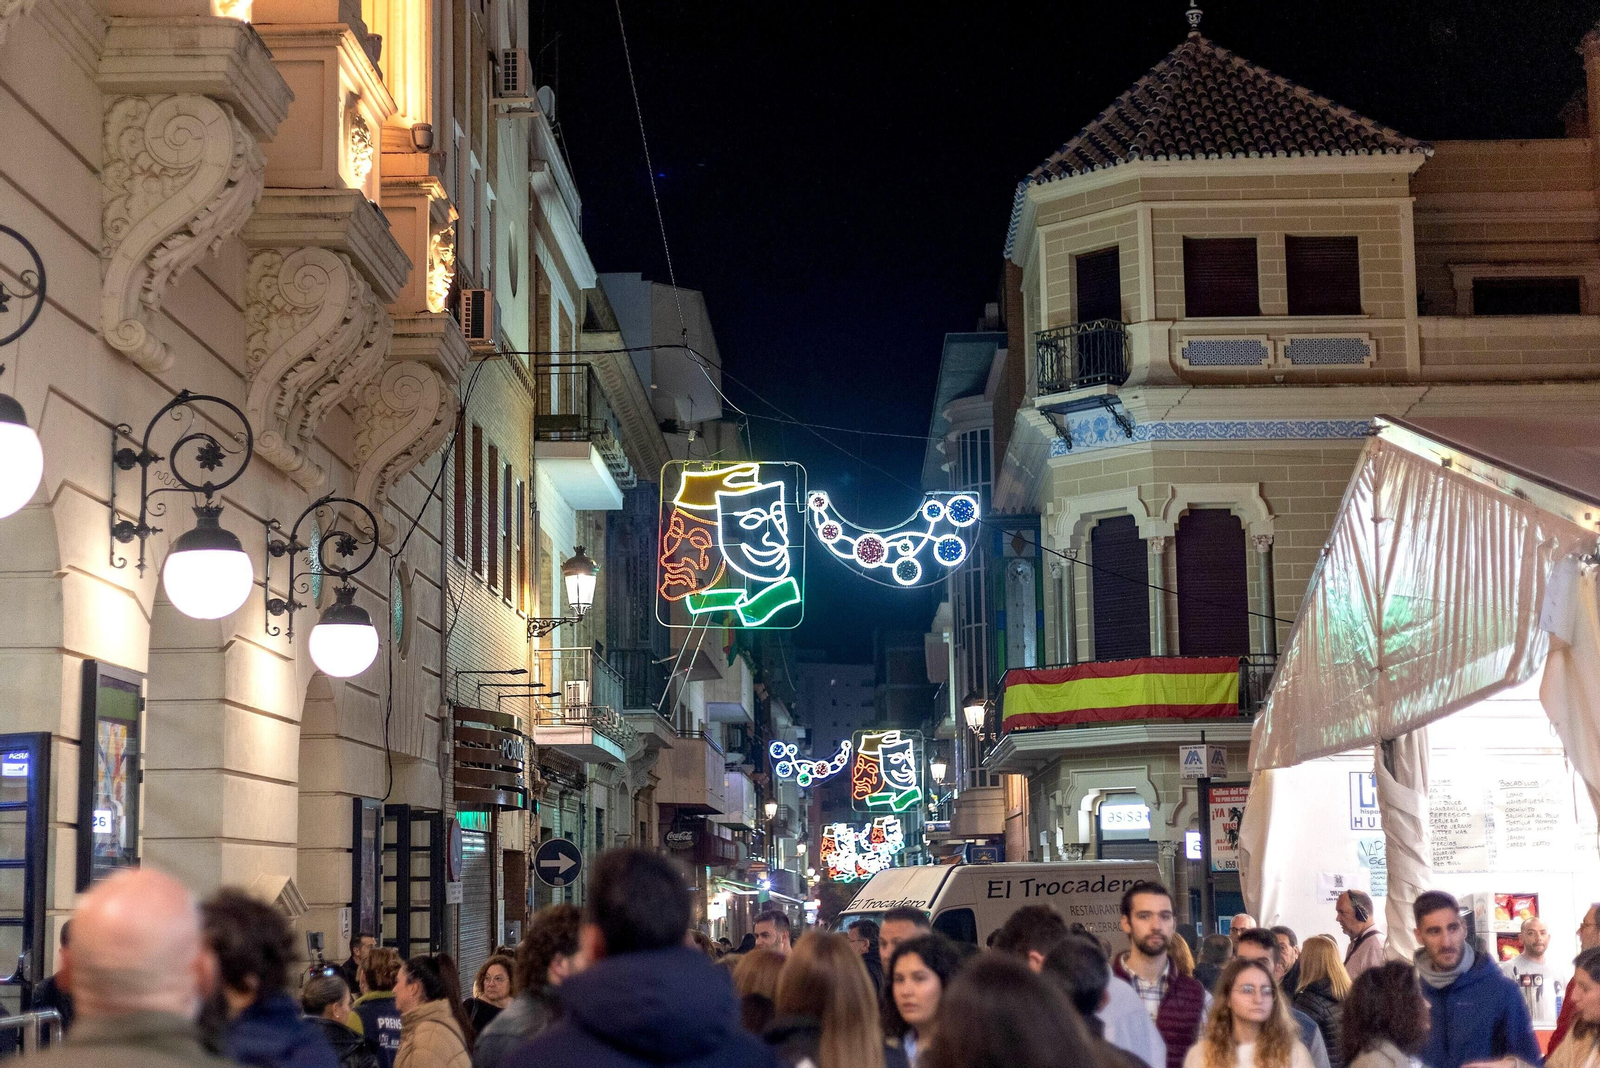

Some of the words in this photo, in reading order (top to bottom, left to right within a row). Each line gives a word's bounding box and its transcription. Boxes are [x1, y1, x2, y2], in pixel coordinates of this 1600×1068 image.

[1498, 779, 1540, 788] BOCADILLOS
[1107, 811, 1142, 822] asisa
[1354, 816, 1383, 828] HU
[1222, 822, 1239, 832] VIS
[1360, 840, 1386, 856] VAP
[987, 880, 1011, 899] El
[848, 899, 861, 911] El
[862, 897, 927, 909] Trocadero
[377, 1017, 402, 1030] PRENS
